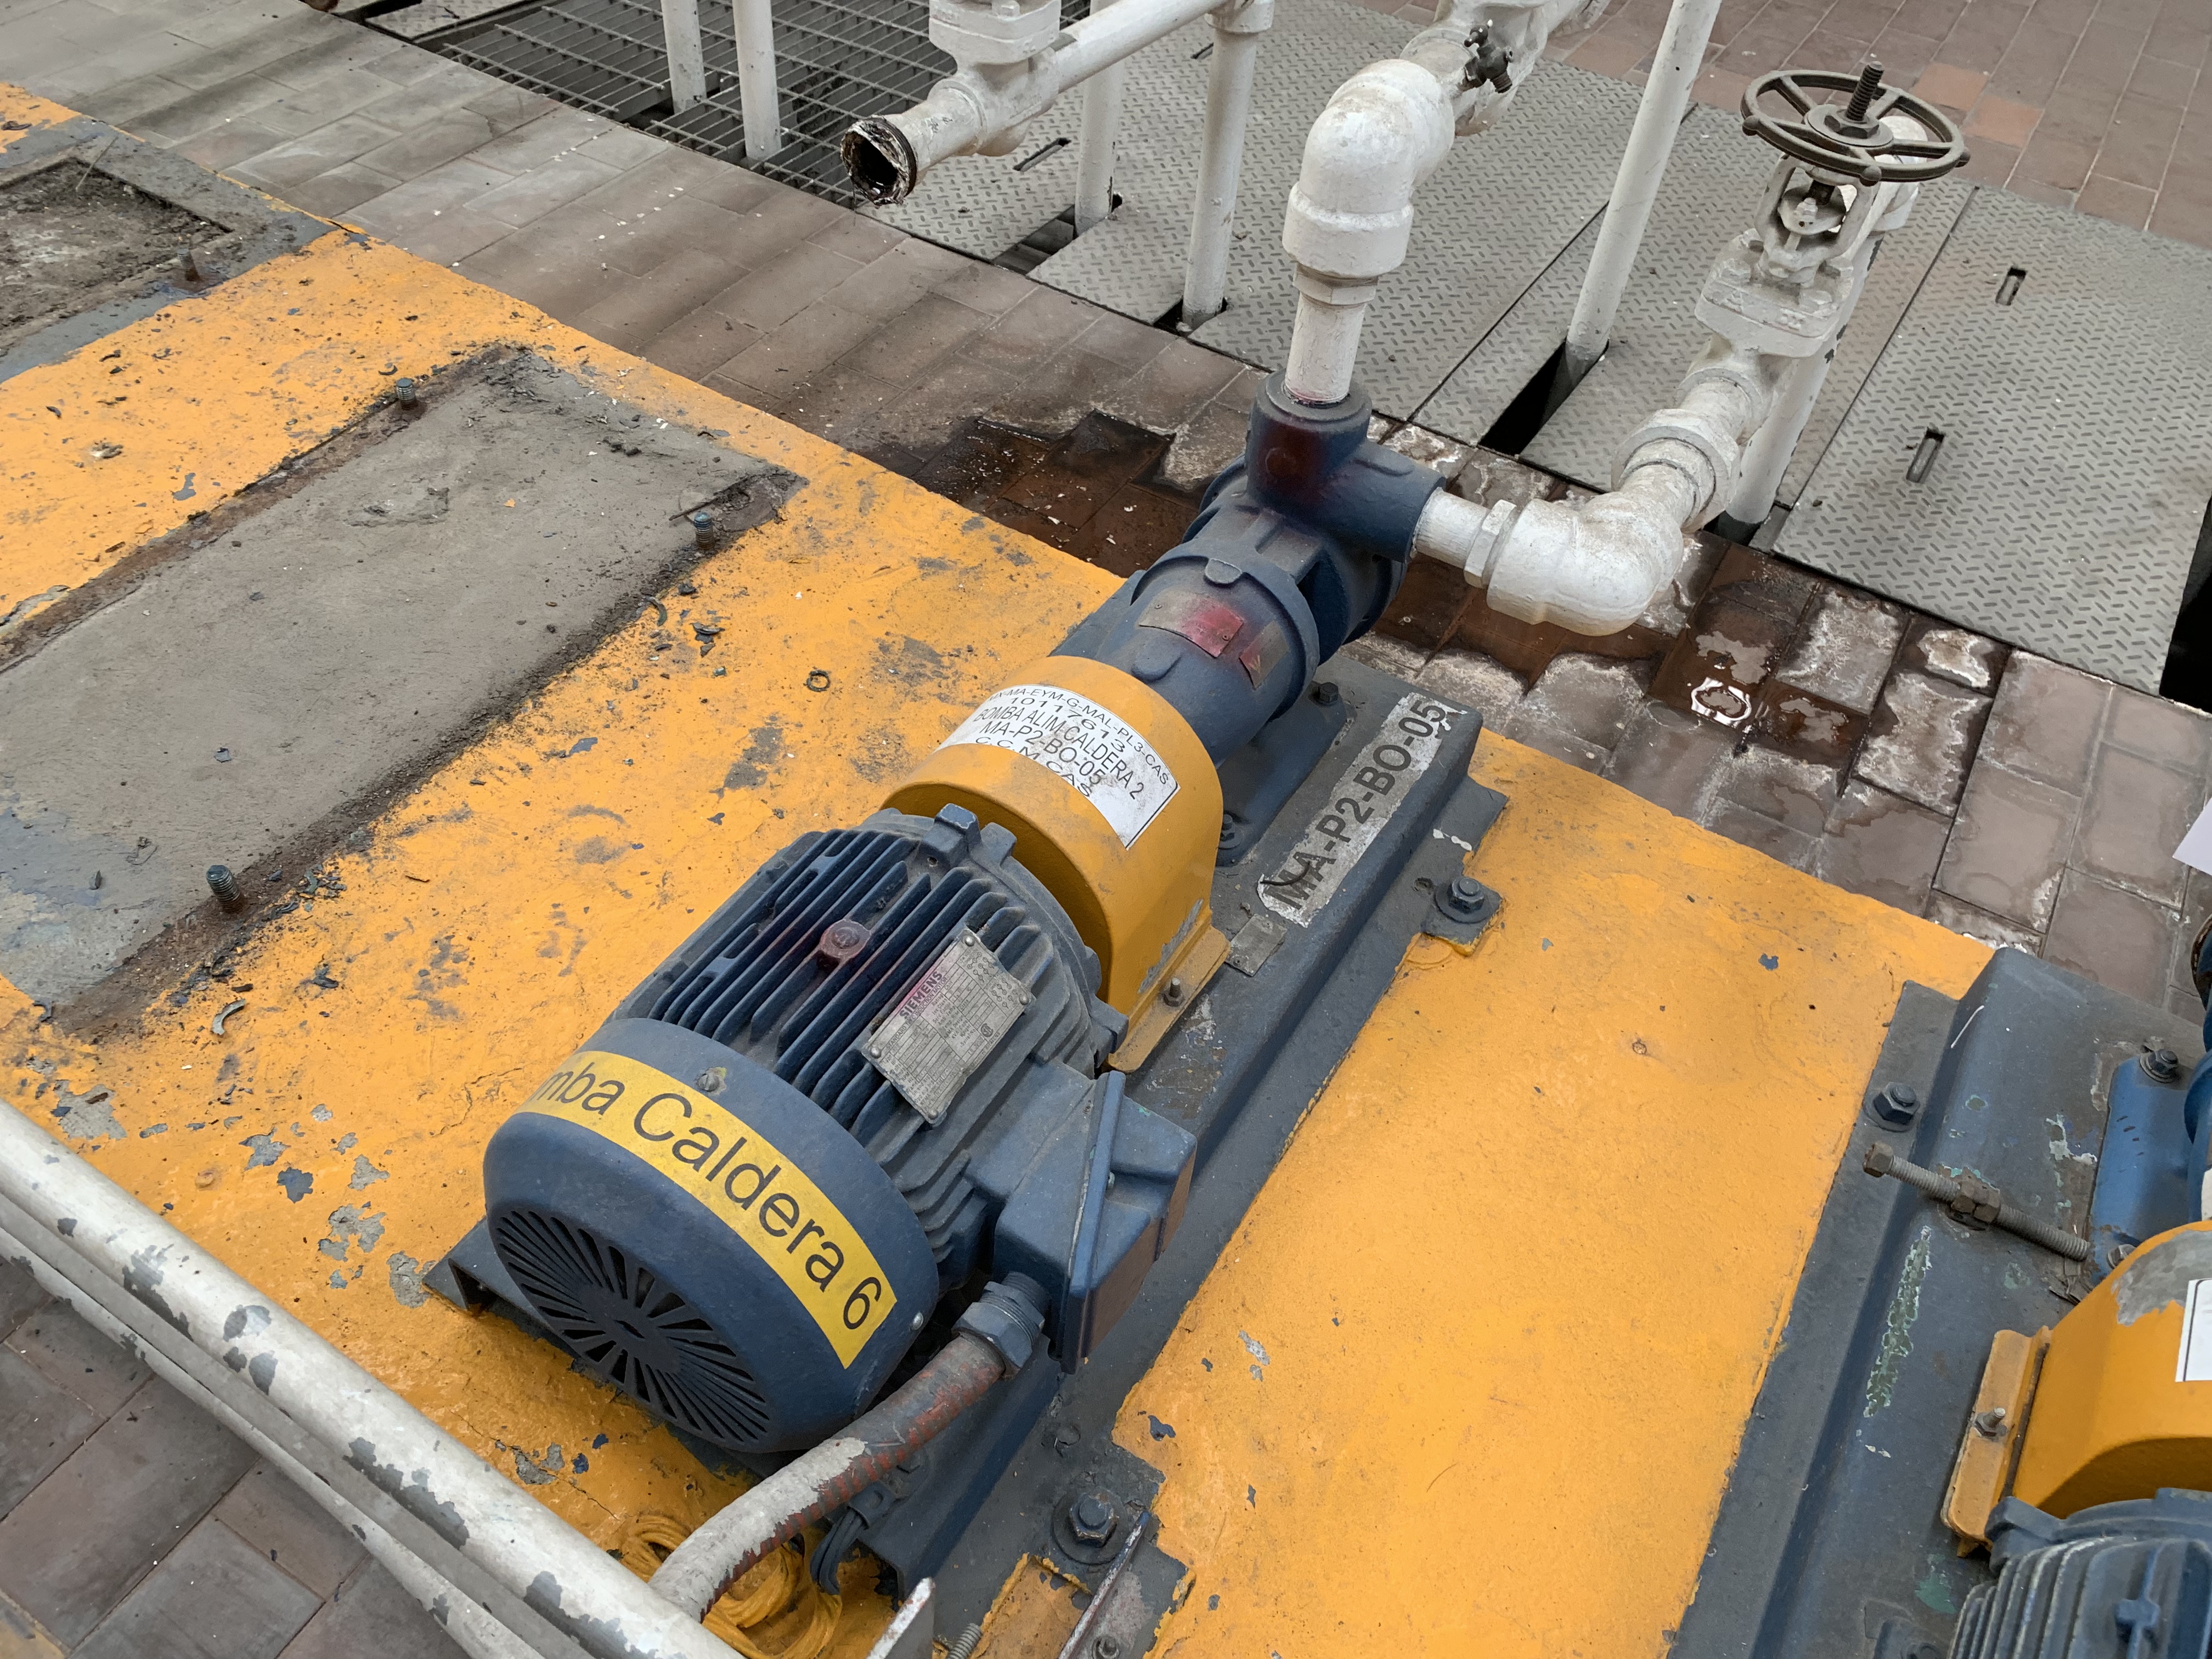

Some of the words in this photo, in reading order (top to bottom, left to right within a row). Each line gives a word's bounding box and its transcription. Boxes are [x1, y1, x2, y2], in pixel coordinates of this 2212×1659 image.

[973, 706, 1025, 722] BOMBA
[1022, 709, 1067, 735] ALIM
[1063, 725, 1134, 789] CALDERA
[1129, 782, 1144, 800] 2
[979, 721, 1106, 785] MA-P2-BO-05
[1046, 761, 1092, 797] CAS
[1263, 700, 1446, 911] MA-P2-BO-05
[898, 969, 944, 1020] SIEMENS
[931, 993, 944, 1007] Rating
[936, 997, 947, 1009] Class
[885, 1025, 907, 1049] STANDARD
[913, 992, 934, 1015] INDUCTION
[932, 977, 948, 994] MOTOR
[932, 1013, 941, 1023] Serv
[939, 1001, 951, 1014] Factor
[946, 1005, 956, 1016] Temp
[943, 1026, 955, 1039] NEMA
[952, 1014, 965, 1028] Design
[951, 1030, 959, 1039] KVA
[958, 1019, 968, 1030] Code
[958, 1023, 972, 1037] Weight
[634, 1093, 845, 1292] Caldera
[843, 1277, 882, 1330] 6
